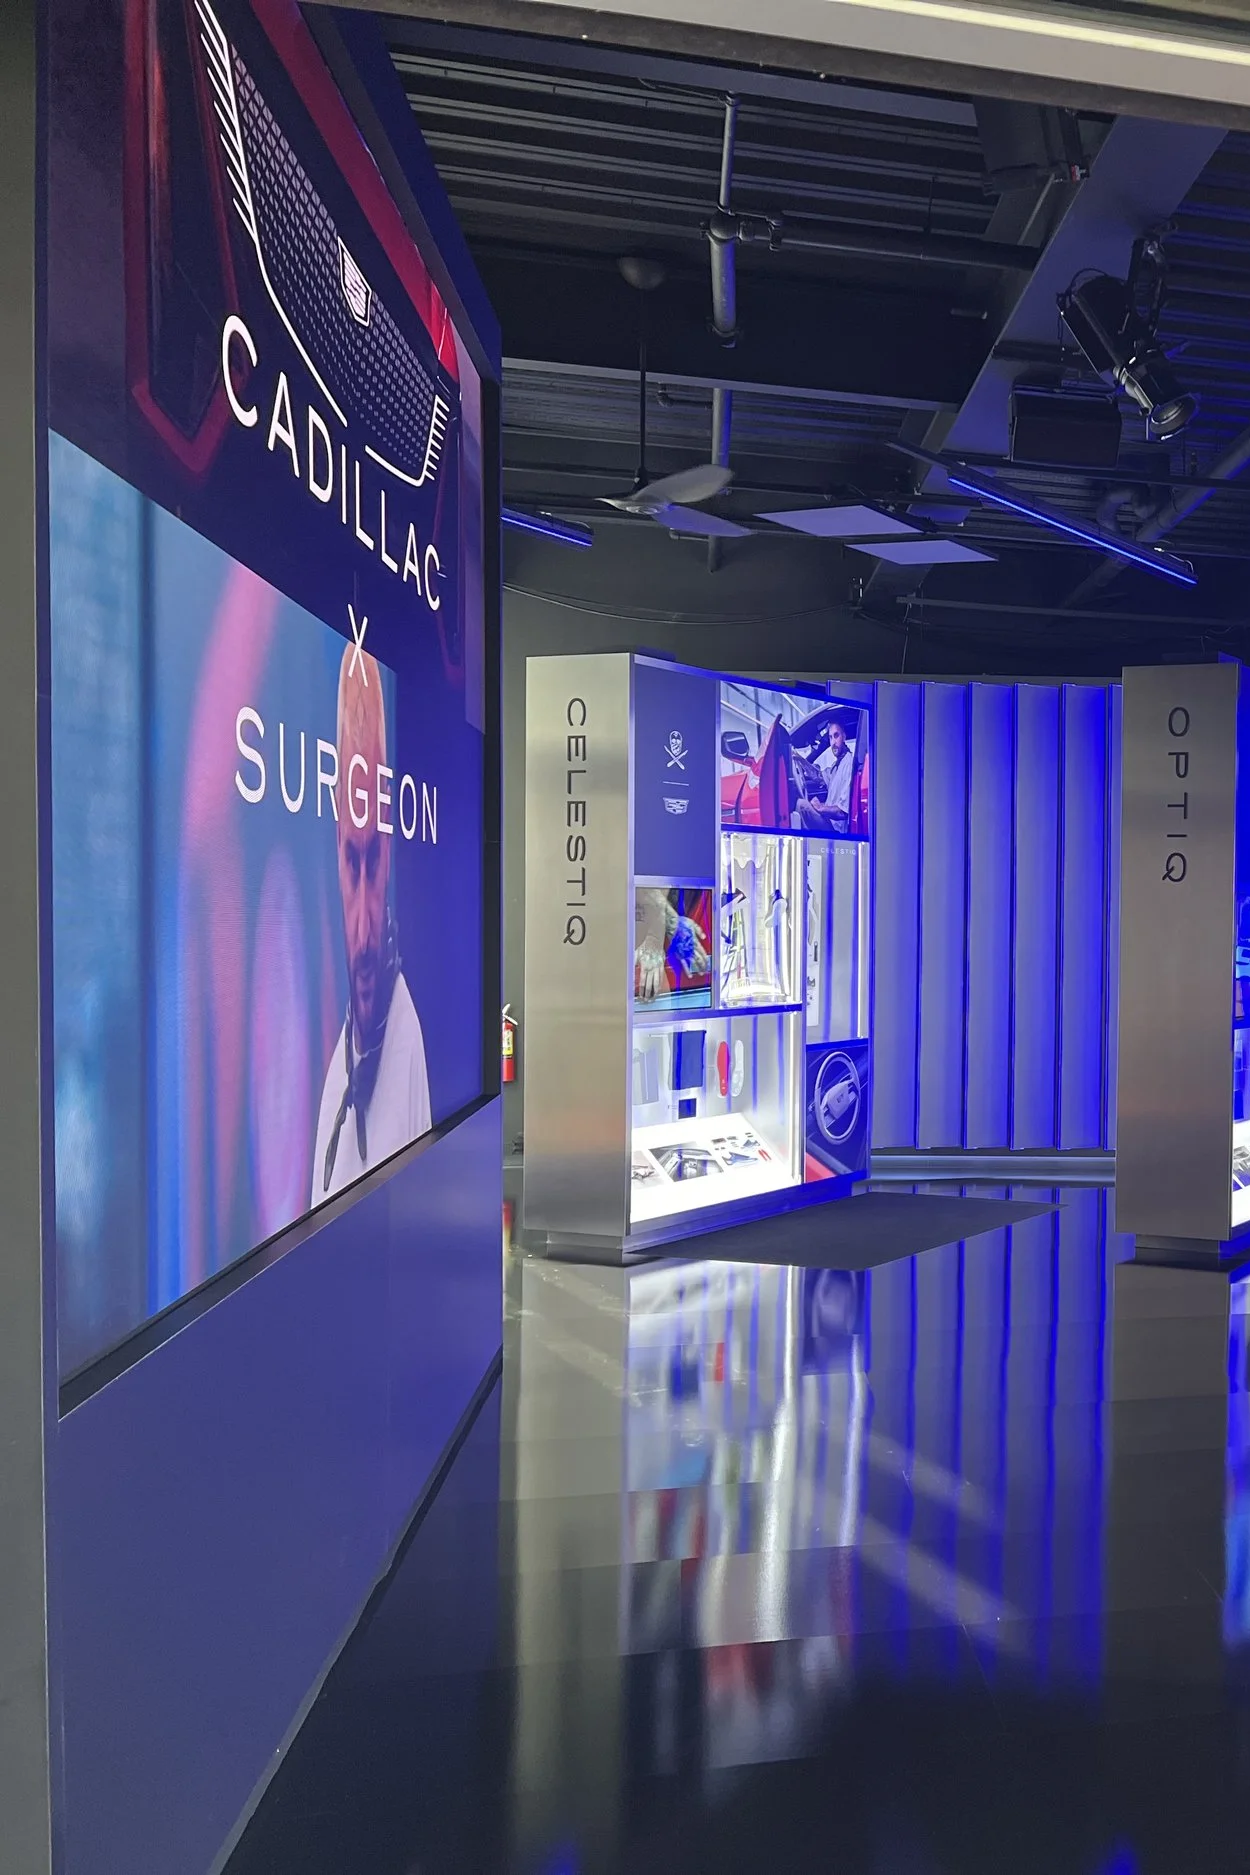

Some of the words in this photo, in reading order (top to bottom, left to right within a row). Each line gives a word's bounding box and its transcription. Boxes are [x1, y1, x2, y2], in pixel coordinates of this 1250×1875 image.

[222, 314, 441, 611] CADILLAC
[234, 706, 438, 845] SURGEON
[563, 697, 587, 946] CELESTIQ
[1161, 706, 1191, 883] OPTIQ
